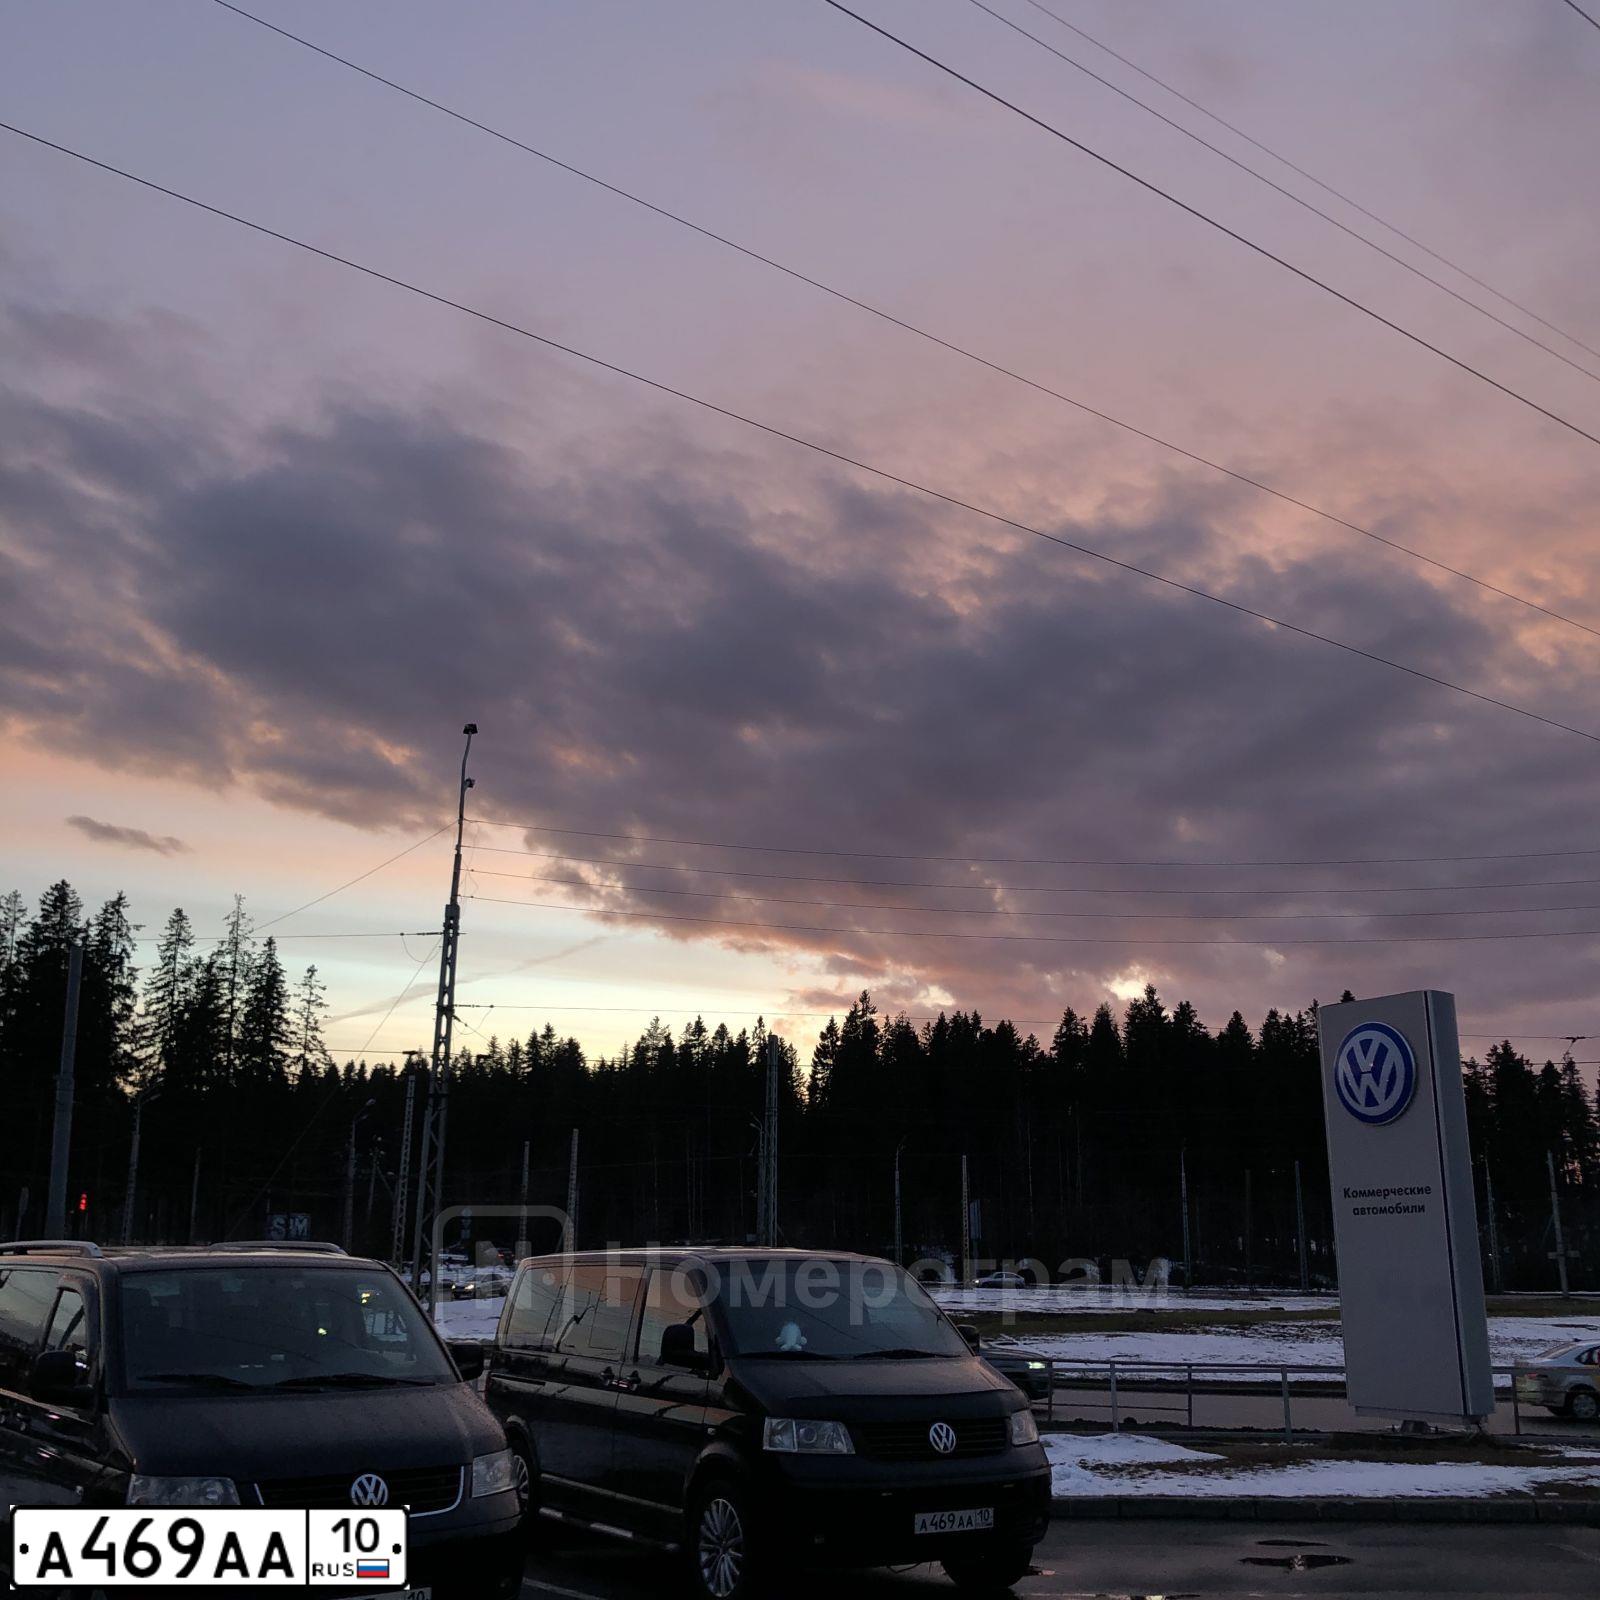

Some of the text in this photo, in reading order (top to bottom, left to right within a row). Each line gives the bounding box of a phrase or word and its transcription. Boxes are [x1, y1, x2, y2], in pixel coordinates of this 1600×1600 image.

[1343, 1185, 1432, 1199] Коммерческие
[1352, 1202, 1426, 1216] автомобили
[920, 1509, 990, 1531] А469АА 10
